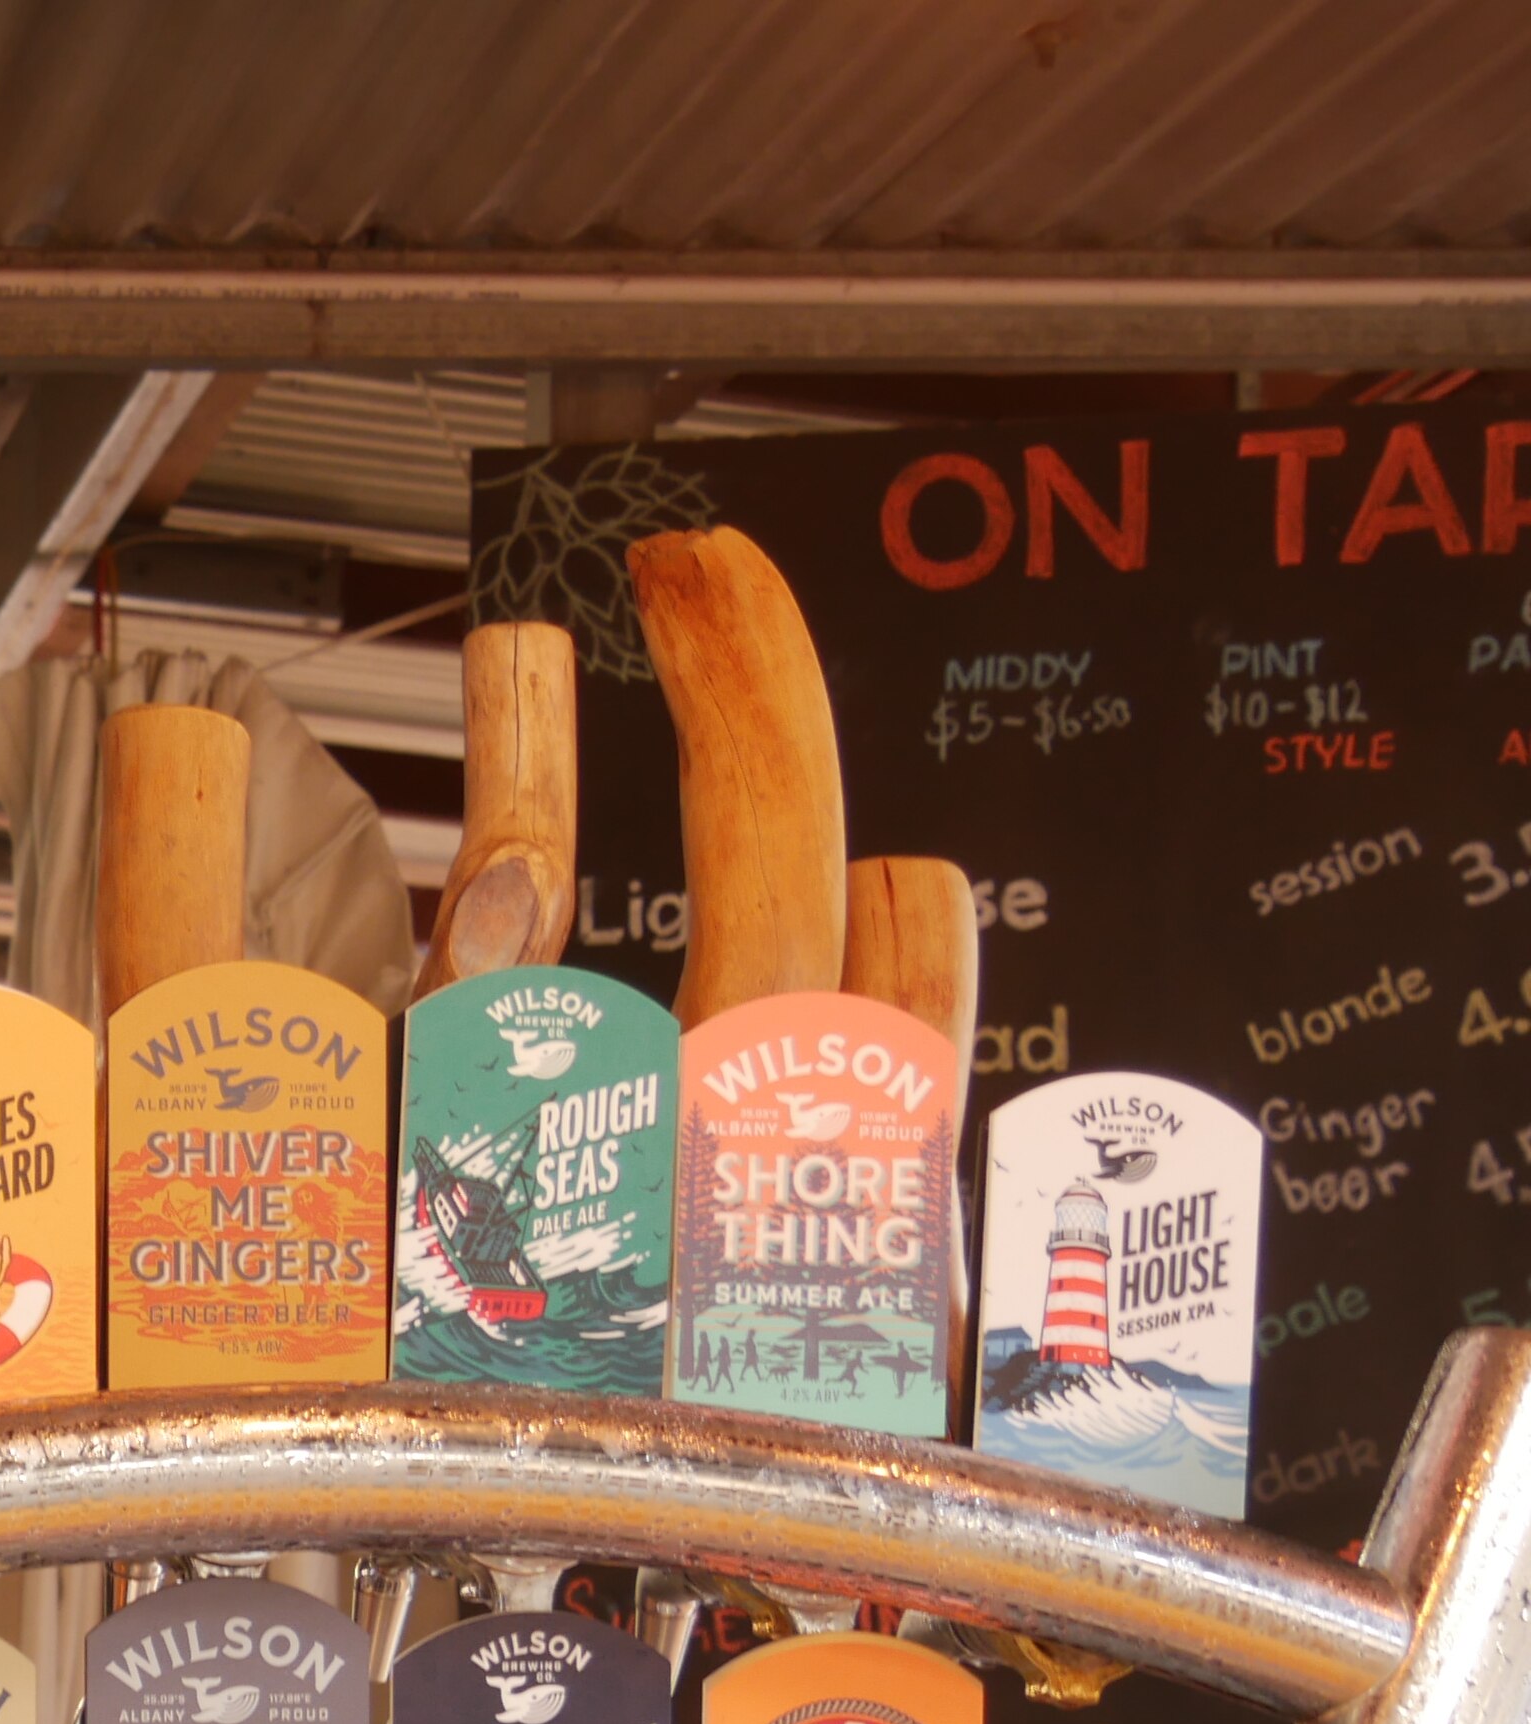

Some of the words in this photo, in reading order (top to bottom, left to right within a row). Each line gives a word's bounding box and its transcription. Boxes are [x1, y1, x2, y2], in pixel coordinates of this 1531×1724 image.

[880, 439, 1151, 590] ON
[946, 651, 1093, 694] MIDDY
[1221, 638, 1324, 680] PINT
[1263, 731, 1396, 774] STYLE
[1248, 825, 1423, 917] session
[485, 986, 604, 1031] WILSON
[514, 1016, 574, 1029] BREWING
[1247, 964, 1433, 1064] blonde
[129, 1006, 363, 1083] WILSON
[702, 1033, 935, 1114] WILSON
[134, 1098, 208, 1113] ALBANY
[288, 1095, 356, 1112] PROUD
[538, 1073, 659, 1156] ROUGH
[1070, 1096, 1185, 1139] WILSON
[1259, 1086, 1439, 1157] Ginger
[705, 1120, 779, 1138] ALBANY
[858, 1124, 926, 1143] PROUD
[1099, 1121, 1157, 1136] BREWING
[145, 1129, 354, 1179] SHIVER
[533, 1142, 620, 1211] SEAS
[712, 1151, 926, 1210] SHORE
[209, 1183, 293, 1233] ME
[532, 1208, 574, 1239] PALE
[576, 1200, 608, 1225] ALE
[1121, 1189, 1219, 1260] LIGHT
[129, 1238, 372, 1288] GINGERS
[712, 1211, 925, 1268] THING
[714, 1281, 843, 1309] SUMMER
[856, 1287, 915, 1310] ALE
[1117, 1239, 1231, 1313] HOUSE
[148, 1304, 259, 1326] GINGER
[274, 1303, 351, 1325] BEER
[1116, 1307, 1182, 1342] SESSION
[1185, 1299, 1217, 1324] XPA
[105, 1617, 346, 1695] WILSON
[469, 1630, 593, 1674] WILSON
[501, 1660, 562, 1673] BREWING
[118, 1708, 187, 1724] ALBANY
[268, 1707, 330, 1723] PROUD
